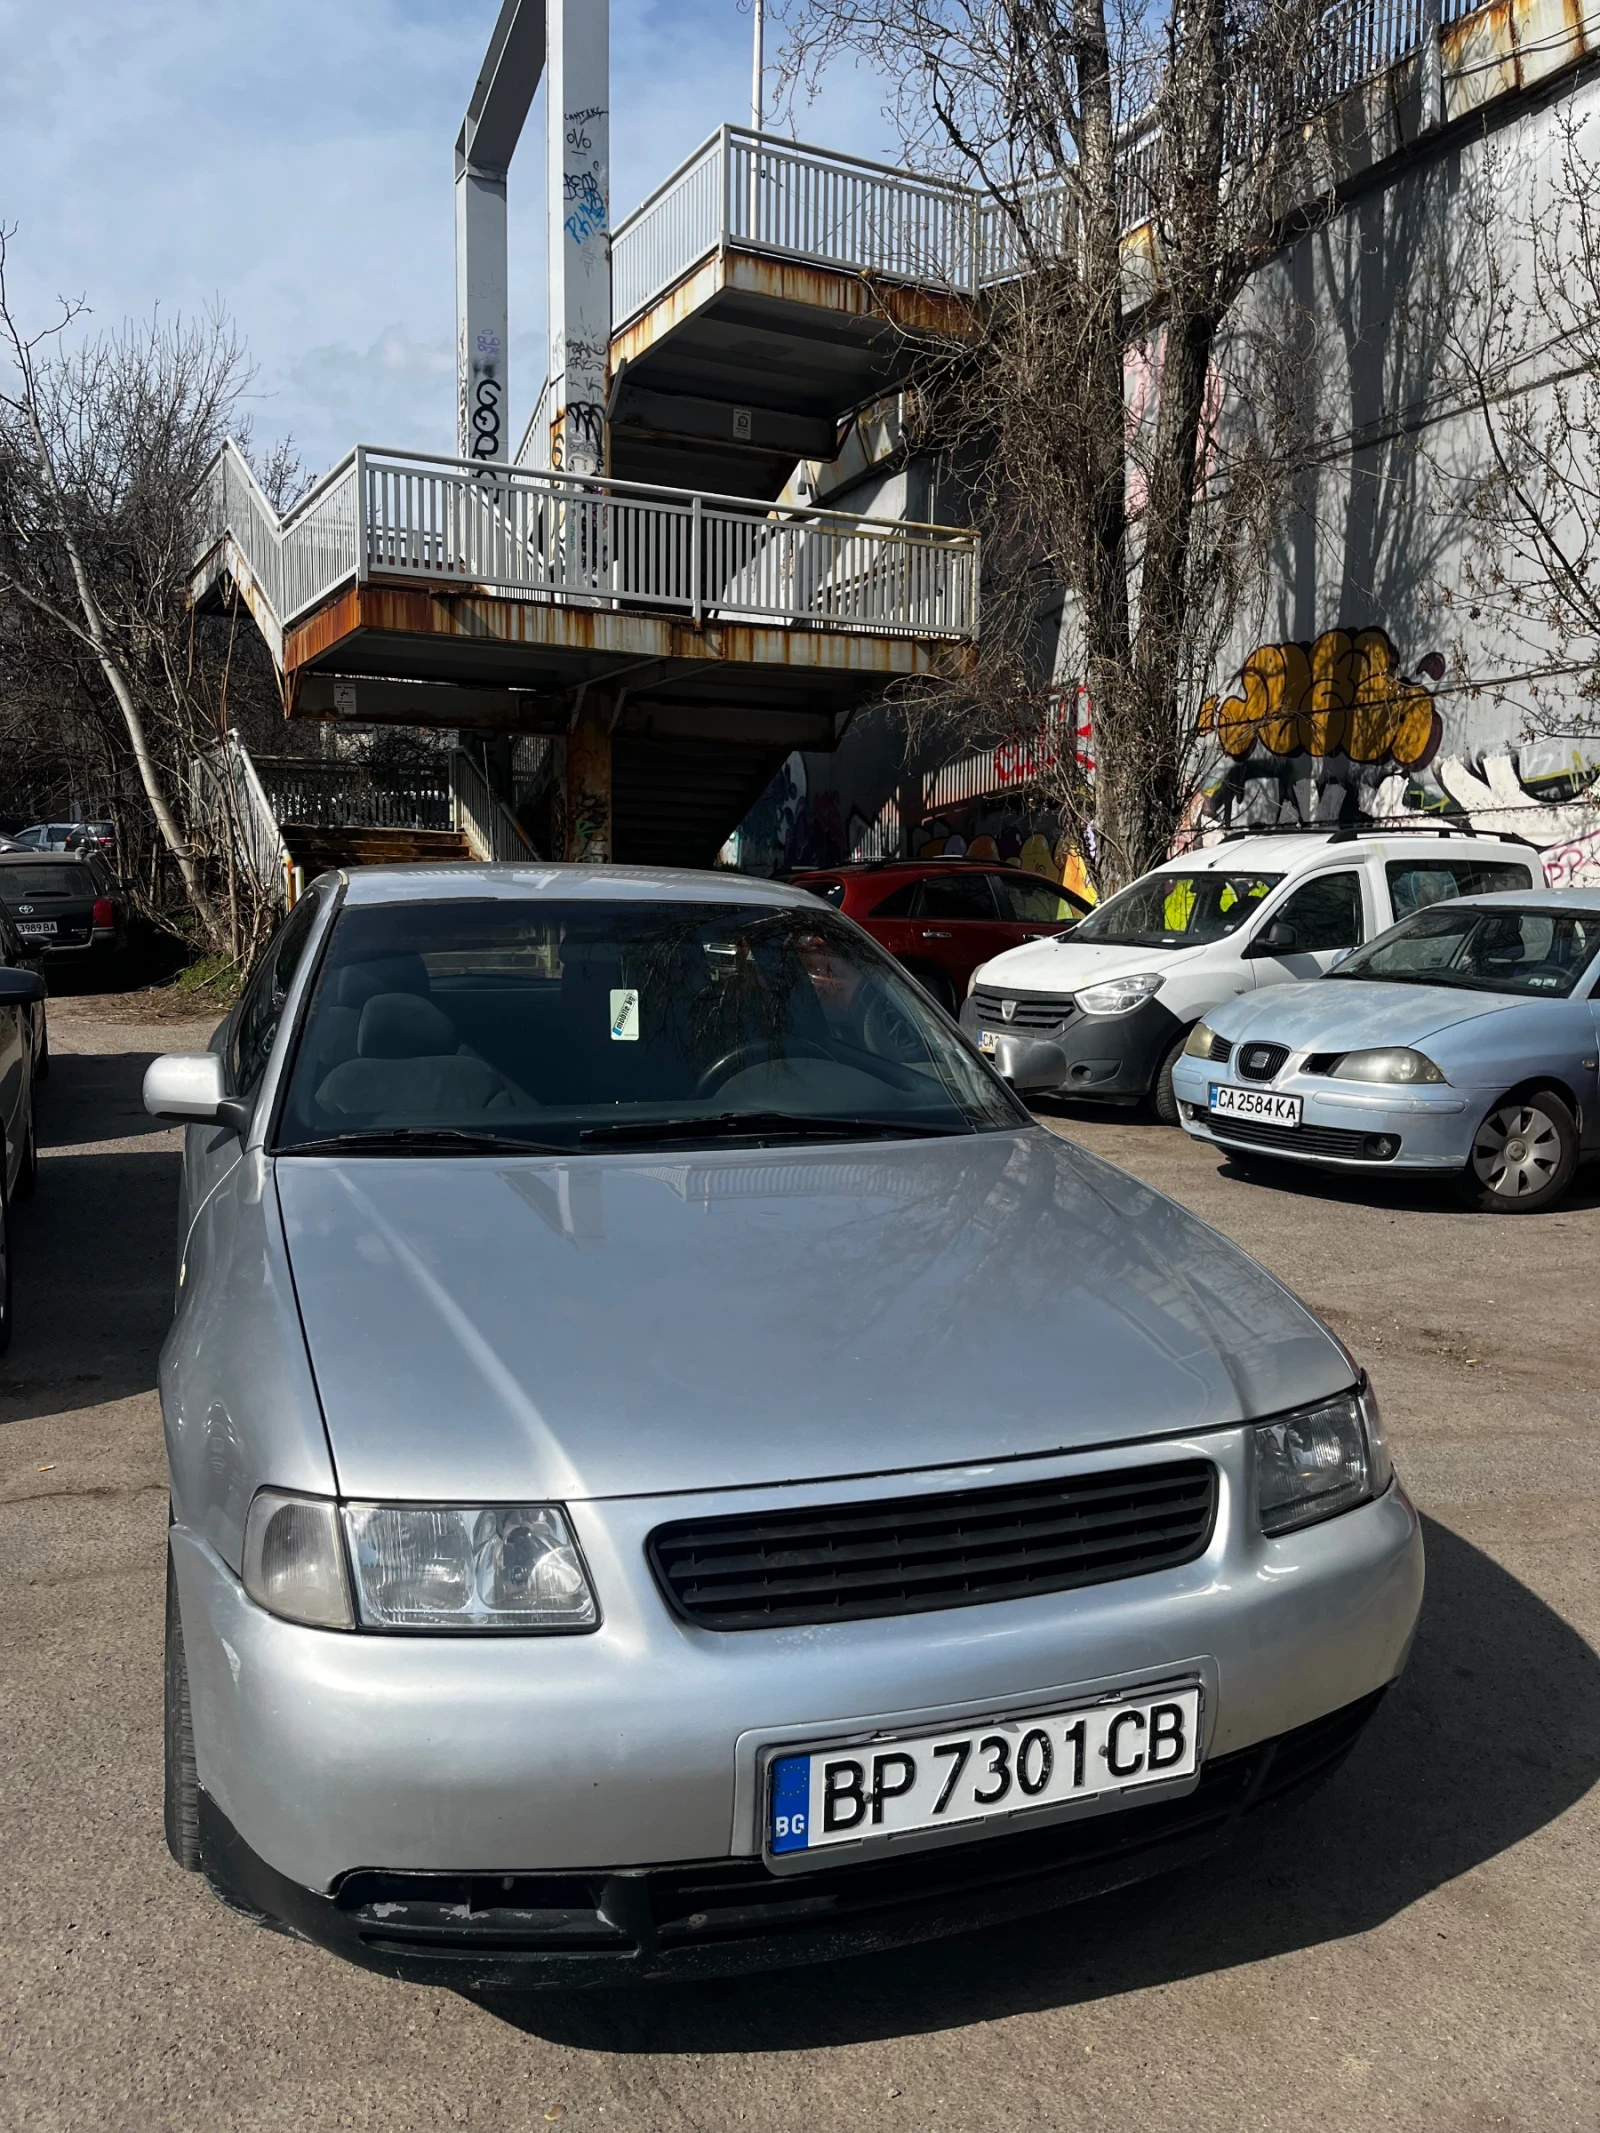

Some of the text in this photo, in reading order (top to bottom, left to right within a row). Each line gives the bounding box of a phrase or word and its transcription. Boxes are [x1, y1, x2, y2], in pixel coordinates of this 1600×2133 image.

[19, 923, 42, 933] 3989
[1218, 1089, 1235, 1110] CA
[1236, 1092, 1273, 1116] 2584
[1274, 1098, 1297, 1120] KA
[823, 1702, 1186, 1834] BP 7301 CB
[775, 1813, 806, 1838] BG
